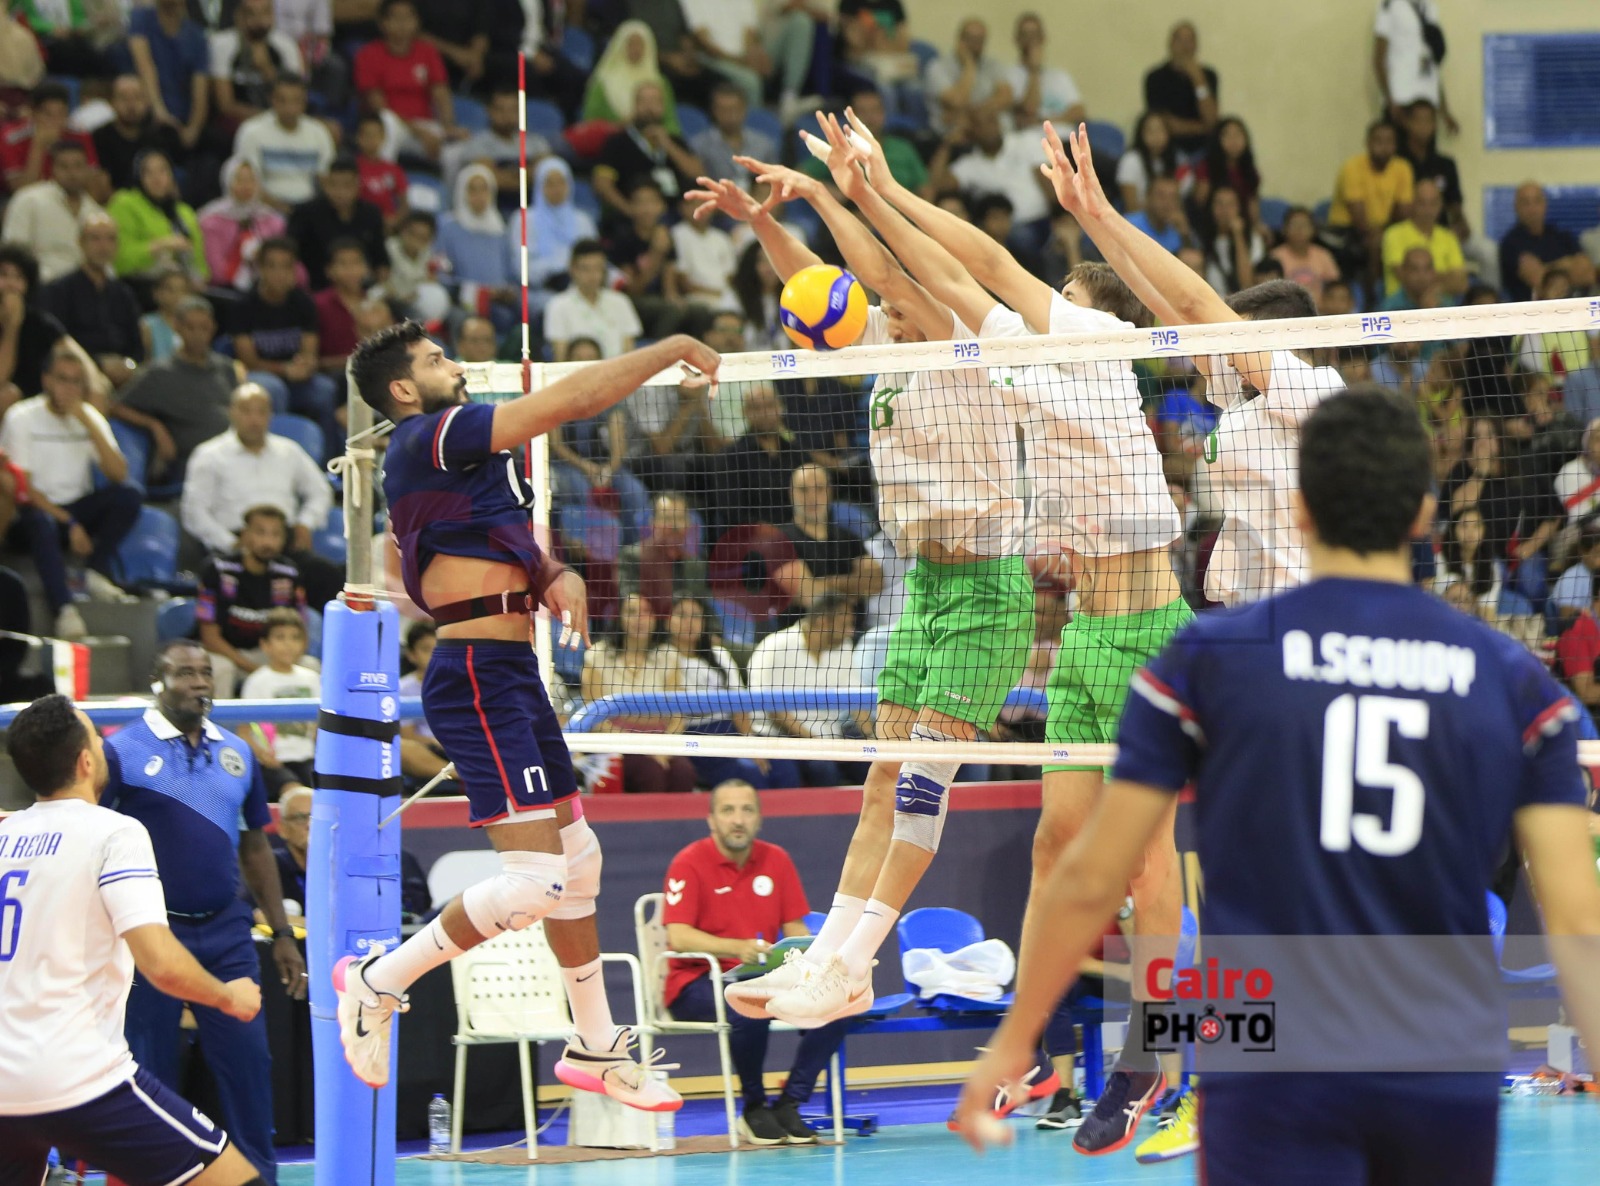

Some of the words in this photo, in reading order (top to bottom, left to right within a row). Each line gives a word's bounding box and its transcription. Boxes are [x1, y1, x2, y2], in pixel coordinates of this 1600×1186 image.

[1362, 317, 1391, 332] FIVB
[1151, 330, 1179, 345] FIVB
[954, 343, 980, 358] FIVB
[772, 354, 796, 368] FIVB
[360, 672, 389, 685] FIVB
[1053, 750, 1068, 758] FIVB
[523, 766, 548, 793] 17
[1320, 693, 1430, 857] 15
